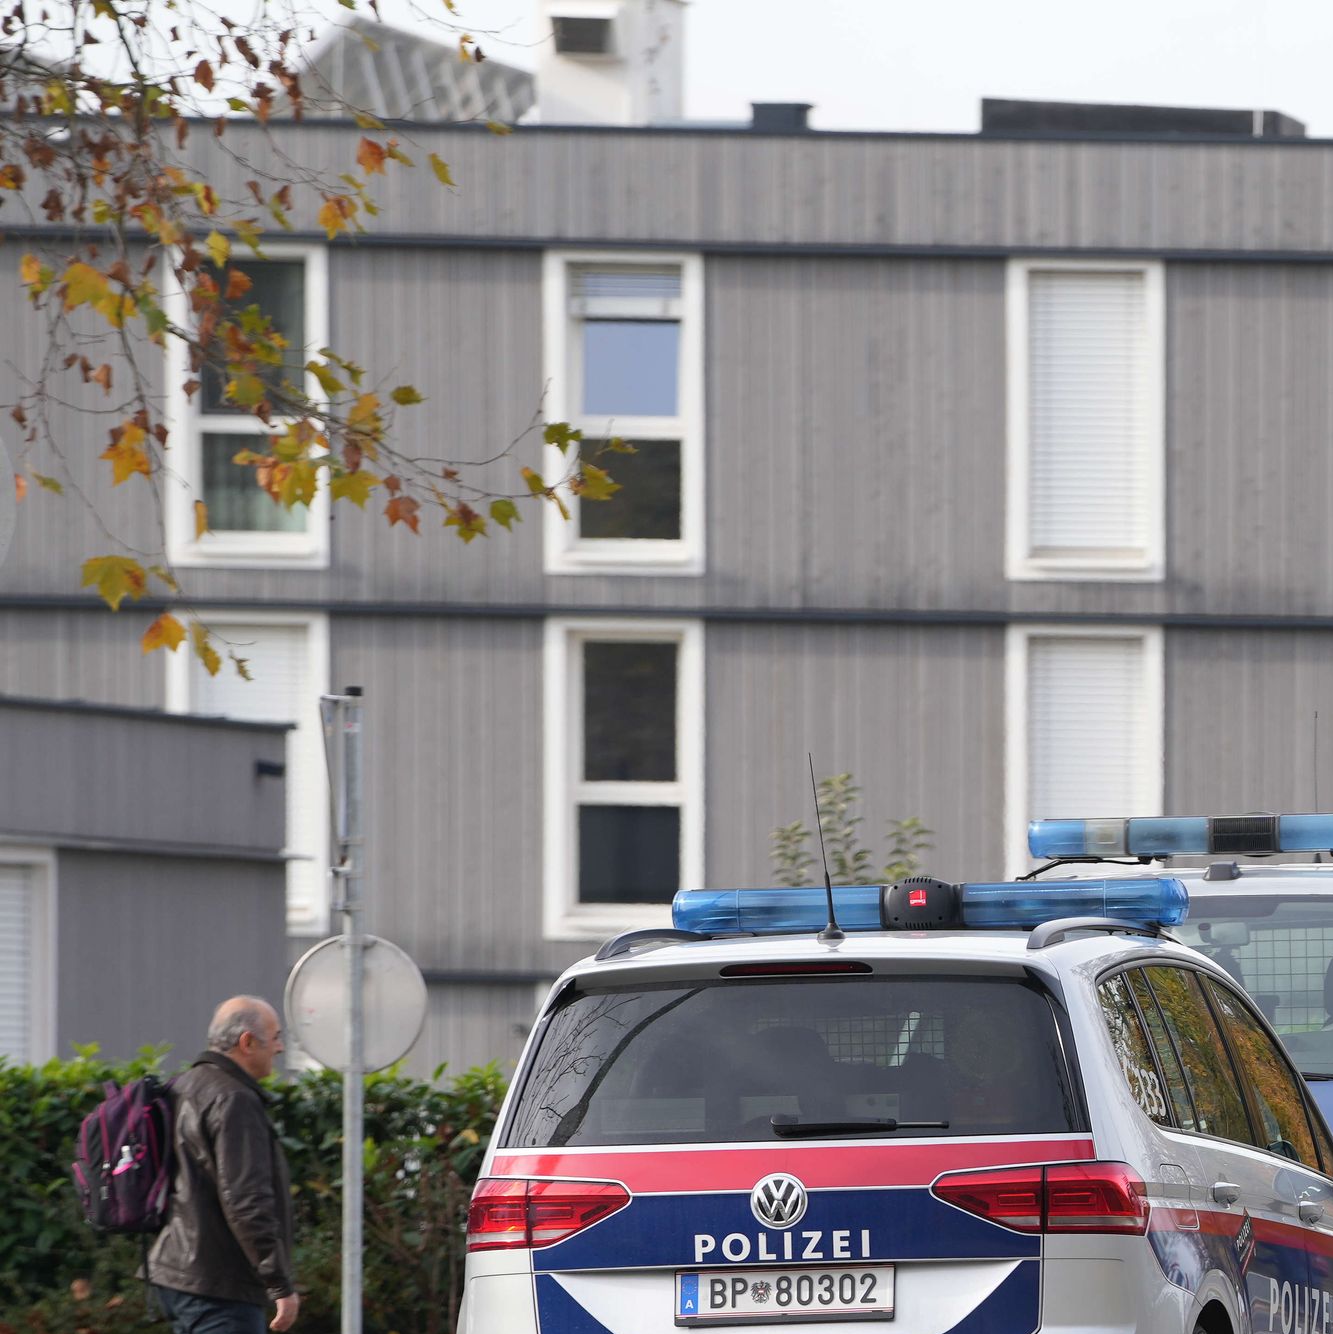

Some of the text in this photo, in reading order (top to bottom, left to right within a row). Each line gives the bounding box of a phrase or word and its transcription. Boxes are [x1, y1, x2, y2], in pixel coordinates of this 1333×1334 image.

[694, 1229, 870, 1262] POLIZEI
[685, 1272, 877, 1309] A BP 80302
